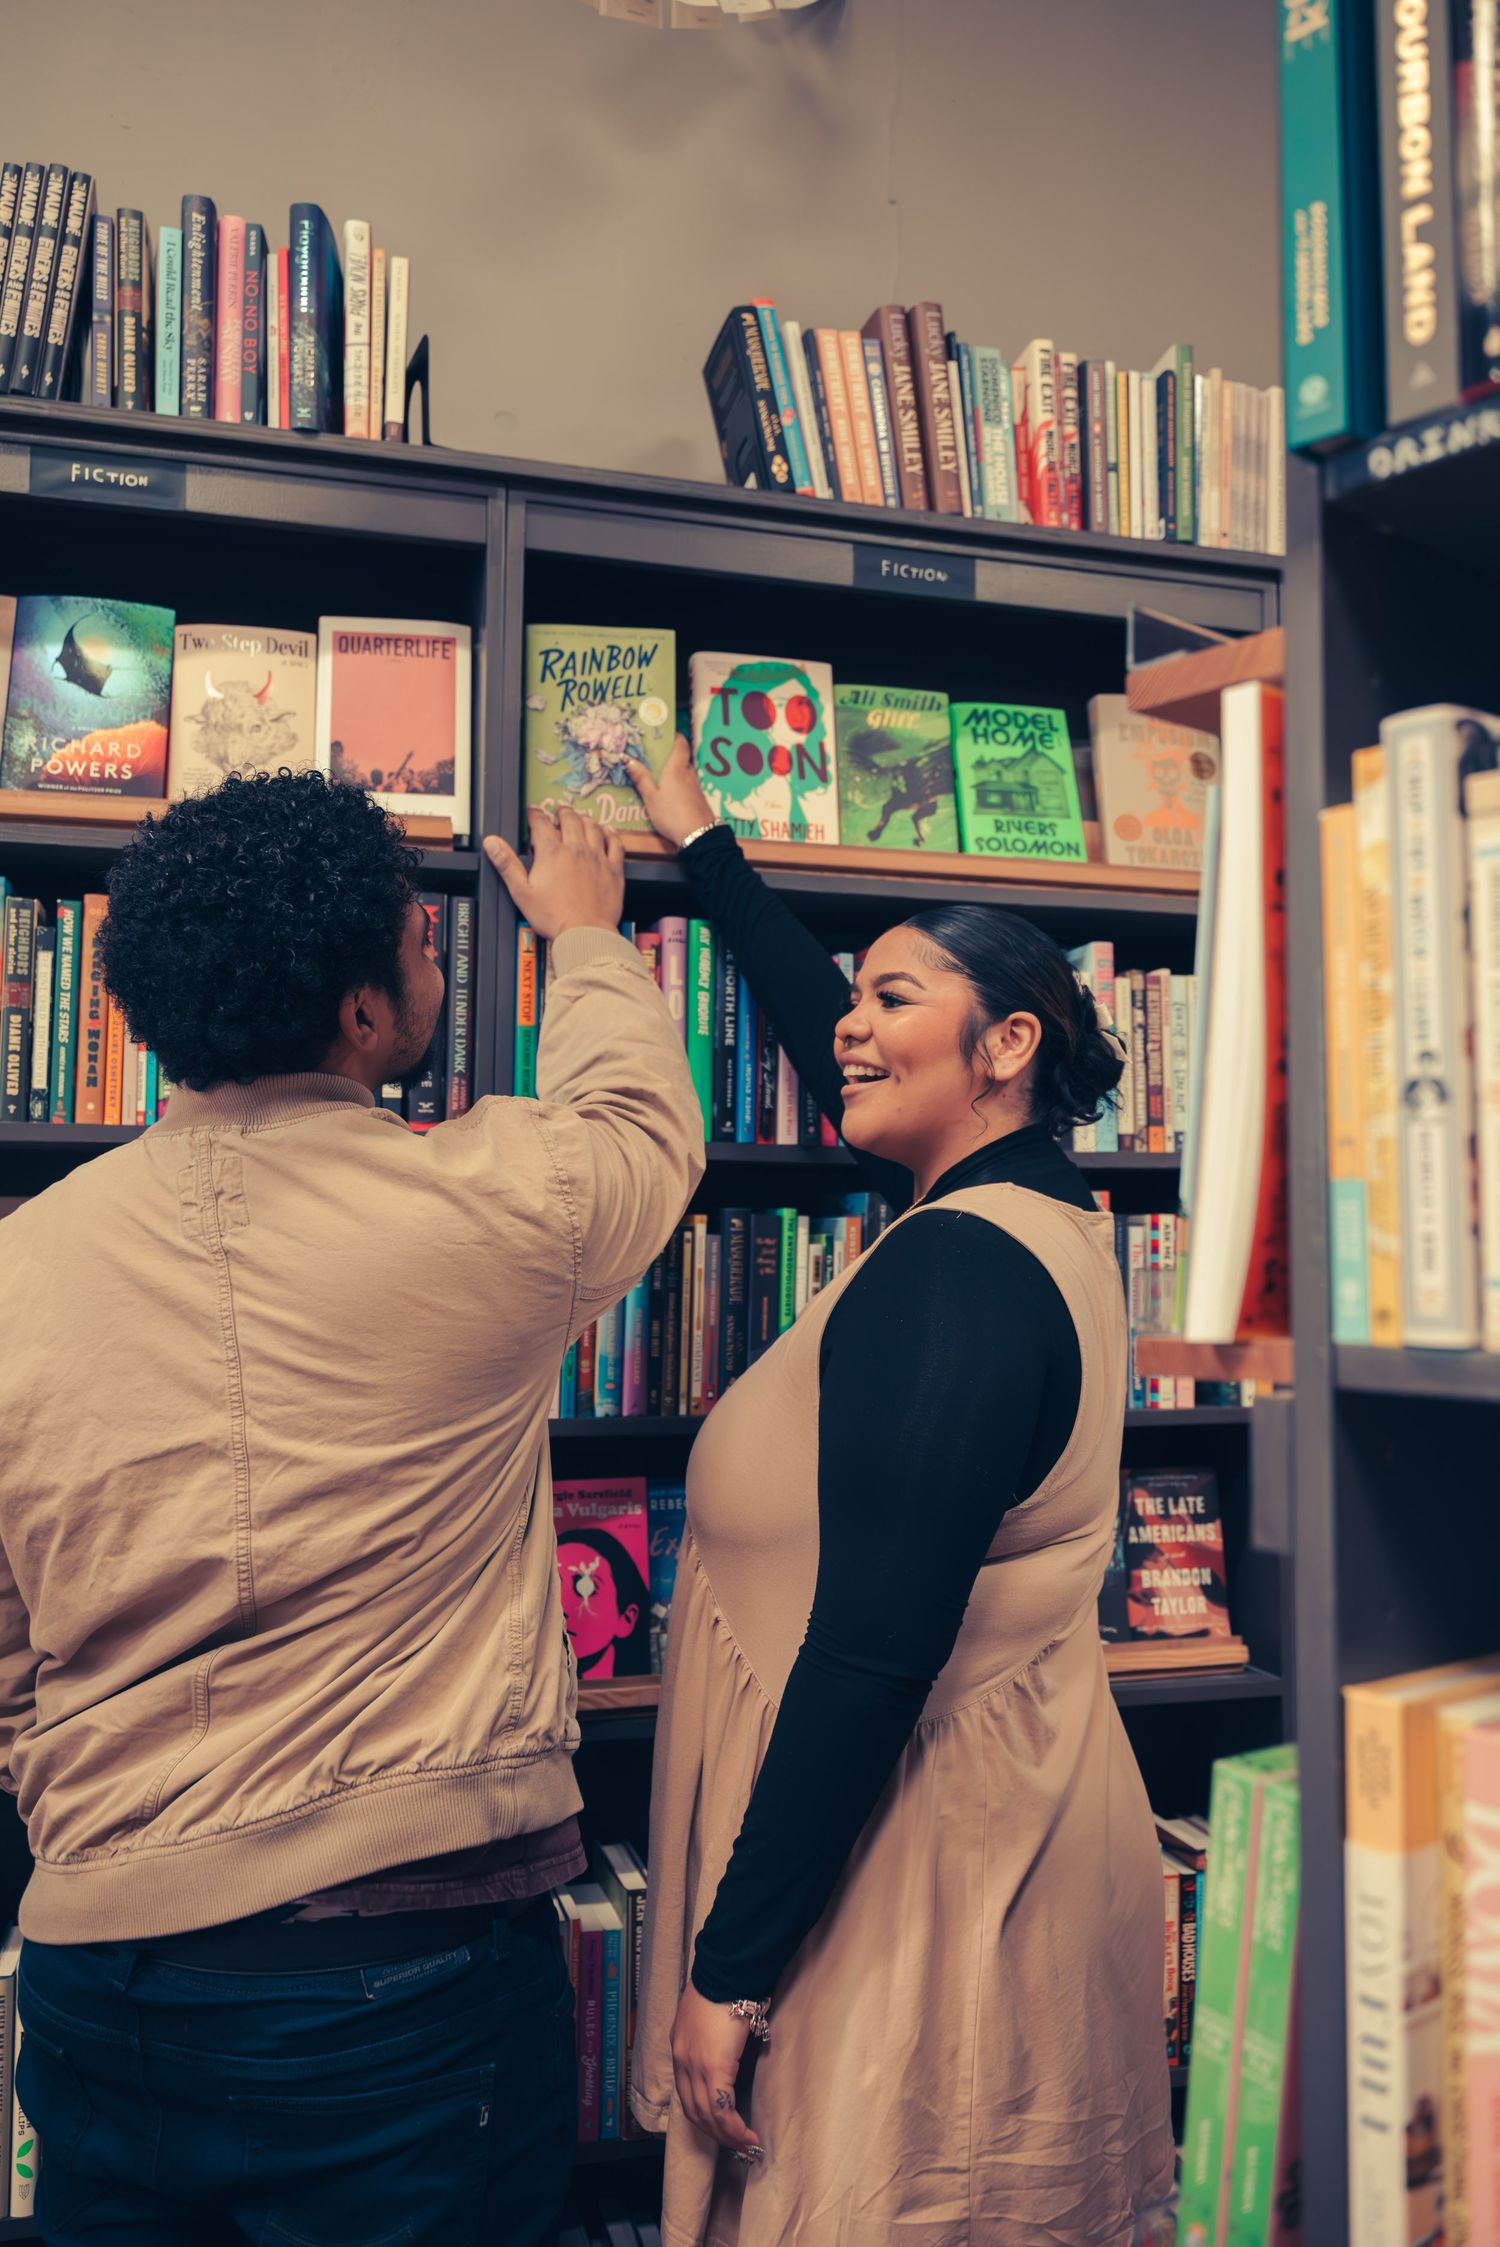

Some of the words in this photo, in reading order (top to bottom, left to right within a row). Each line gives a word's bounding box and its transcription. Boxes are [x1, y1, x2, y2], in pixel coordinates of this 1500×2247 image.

[243, 337, 256, 374] BOY
[1040, 347, 1052, 379] FIRE
[892, 361, 914, 406] JANE
[928, 360, 949, 405] JANE
[1041, 383, 1054, 414] EXIT
[898, 408, 924, 476] SMILEY
[933, 407, 958, 474] SMILEY
[71, 463, 149, 488] FICTION
[881, 559, 948, 583] FICTION
[180, 633, 215, 650] Two
[221, 633, 262, 657] Step
[266, 636, 309, 658] Devil
[338, 635, 451, 660] QUARTERLIFE
[538, 642, 659, 684] RAINBOW
[556, 672, 647, 713] ROWELL
[881, 692, 944, 713] Smith
[709, 686, 818, 735] TOO
[962, 707, 1060, 733] MODEL
[25, 735, 142, 759] RICHARD
[970, 726, 1055, 750] HOME
[30, 758, 133, 781] POWERS
[704, 736, 829, 784] SOON
[760, 818, 826, 841] SHAMIEH
[993, 818, 1058, 837] RIVERS
[974, 836, 1081, 857] SOLOMON
[62, 908, 75, 936] HOW
[456, 902, 470, 950] BRIGHT
[16, 908, 31, 976] NEIGHBORS
[61, 937, 74, 954] WE
[60, 955, 72, 990] NAMED
[455, 953, 469, 984] AND
[522, 959, 533, 989] NEXT
[59, 992, 71, 1010] THE
[724, 964, 736, 1013] NORTH
[454, 988, 468, 1036] TENDER
[521, 991, 533, 1022] STOP
[7, 1014, 22, 1052] DIANE
[57, 1012, 70, 1043] STARS
[724, 1016, 735, 1047] LINE
[453, 1038, 467, 1074] DARK
[6, 1053, 21, 1097] OLIVER
[566, 1501, 643, 1520] Vulgaris
[650, 1497, 686, 1512] REBE
[1134, 1496, 1165, 1516] THE
[1167, 1495, 1207, 1515] LATE
[1127, 1522, 1217, 1545] AMERICANS
[1140, 1567, 1212, 1589] BRANDON
[1150, 1595, 1208, 1616] TAYLOR
[1182, 1922, 1195, 1944] BAD
[422, 1949, 457, 1970] QUALITY
[1181, 1945, 1195, 1982] HOUSES
